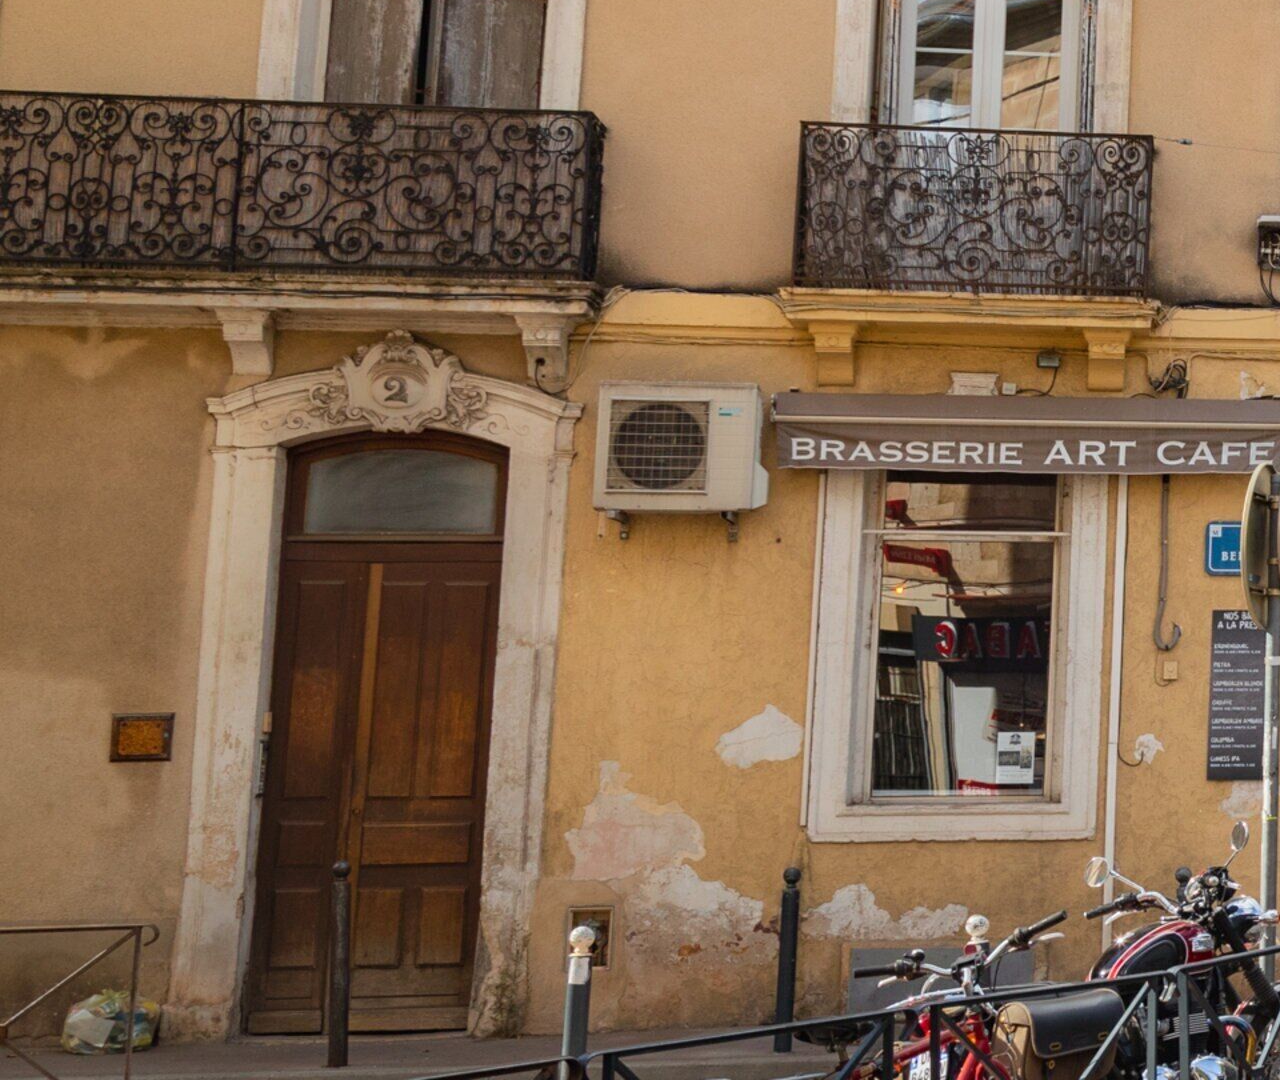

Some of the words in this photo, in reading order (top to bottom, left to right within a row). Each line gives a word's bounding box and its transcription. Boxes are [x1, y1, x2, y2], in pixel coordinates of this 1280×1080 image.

[384, 376, 408, 403] 2
[790, 438, 1023, 465] BRASSERIE
[1044, 440, 1137, 466] ART
[1156, 440, 1276, 467] CAFE
[1226, 621, 1237, 629] LA
